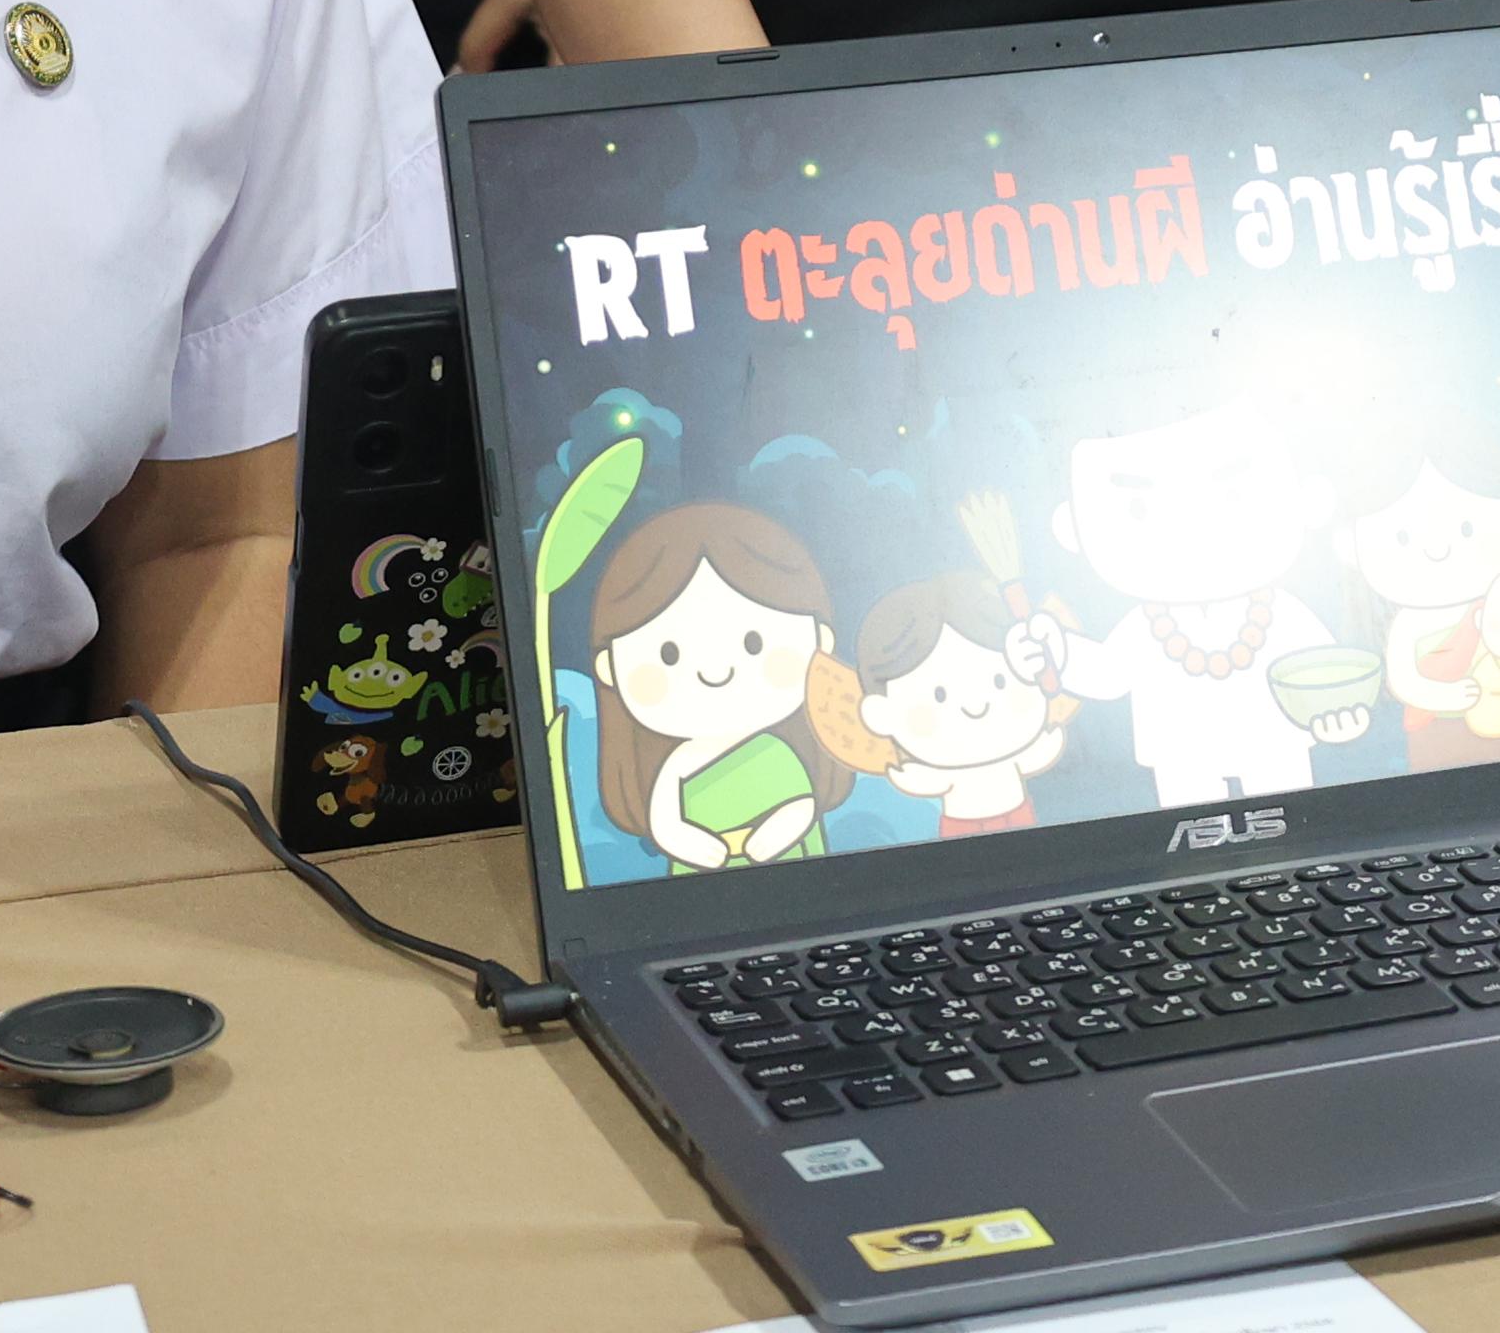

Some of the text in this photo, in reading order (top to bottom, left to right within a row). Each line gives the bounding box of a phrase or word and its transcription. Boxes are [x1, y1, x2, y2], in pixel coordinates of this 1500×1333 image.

[563, 223, 708, 345] RT
[738, 154, 1210, 352] ตะลุยด่านผี
[1166, 806, 1287, 853] ASUS
[1346, 881, 1363, 893] 9
[1132, 915, 1150, 927] 6
[1263, 922, 1285, 935] U
[1192, 934, 1209, 947] Y
[1384, 934, 1404, 947] K
[910, 951, 929, 964] 3
[1118, 946, 1135, 959] T
[835, 963, 854, 976] 2
[1046, 959, 1065, 972] R
[1236, 956, 1259, 970] H
[971, 971, 989, 984] E
[1161, 969, 1186, 982] G
[1376, 964, 1401, 978] M
[1301, 975, 1324, 989] N
[888, 982, 917, 996] W
[1090, 982, 1107, 996] F
[816, 995, 842, 1008] Q
[1013, 993, 1035, 1007] D
[939, 1006, 958, 1019] S
[1150, 1001, 1170, 1015] V
[863, 1019, 884, 1033] A
[1076, 1014, 1099, 1028] C
[1000, 1027, 1020, 1041] X
[924, 1039, 945, 1053] Z
